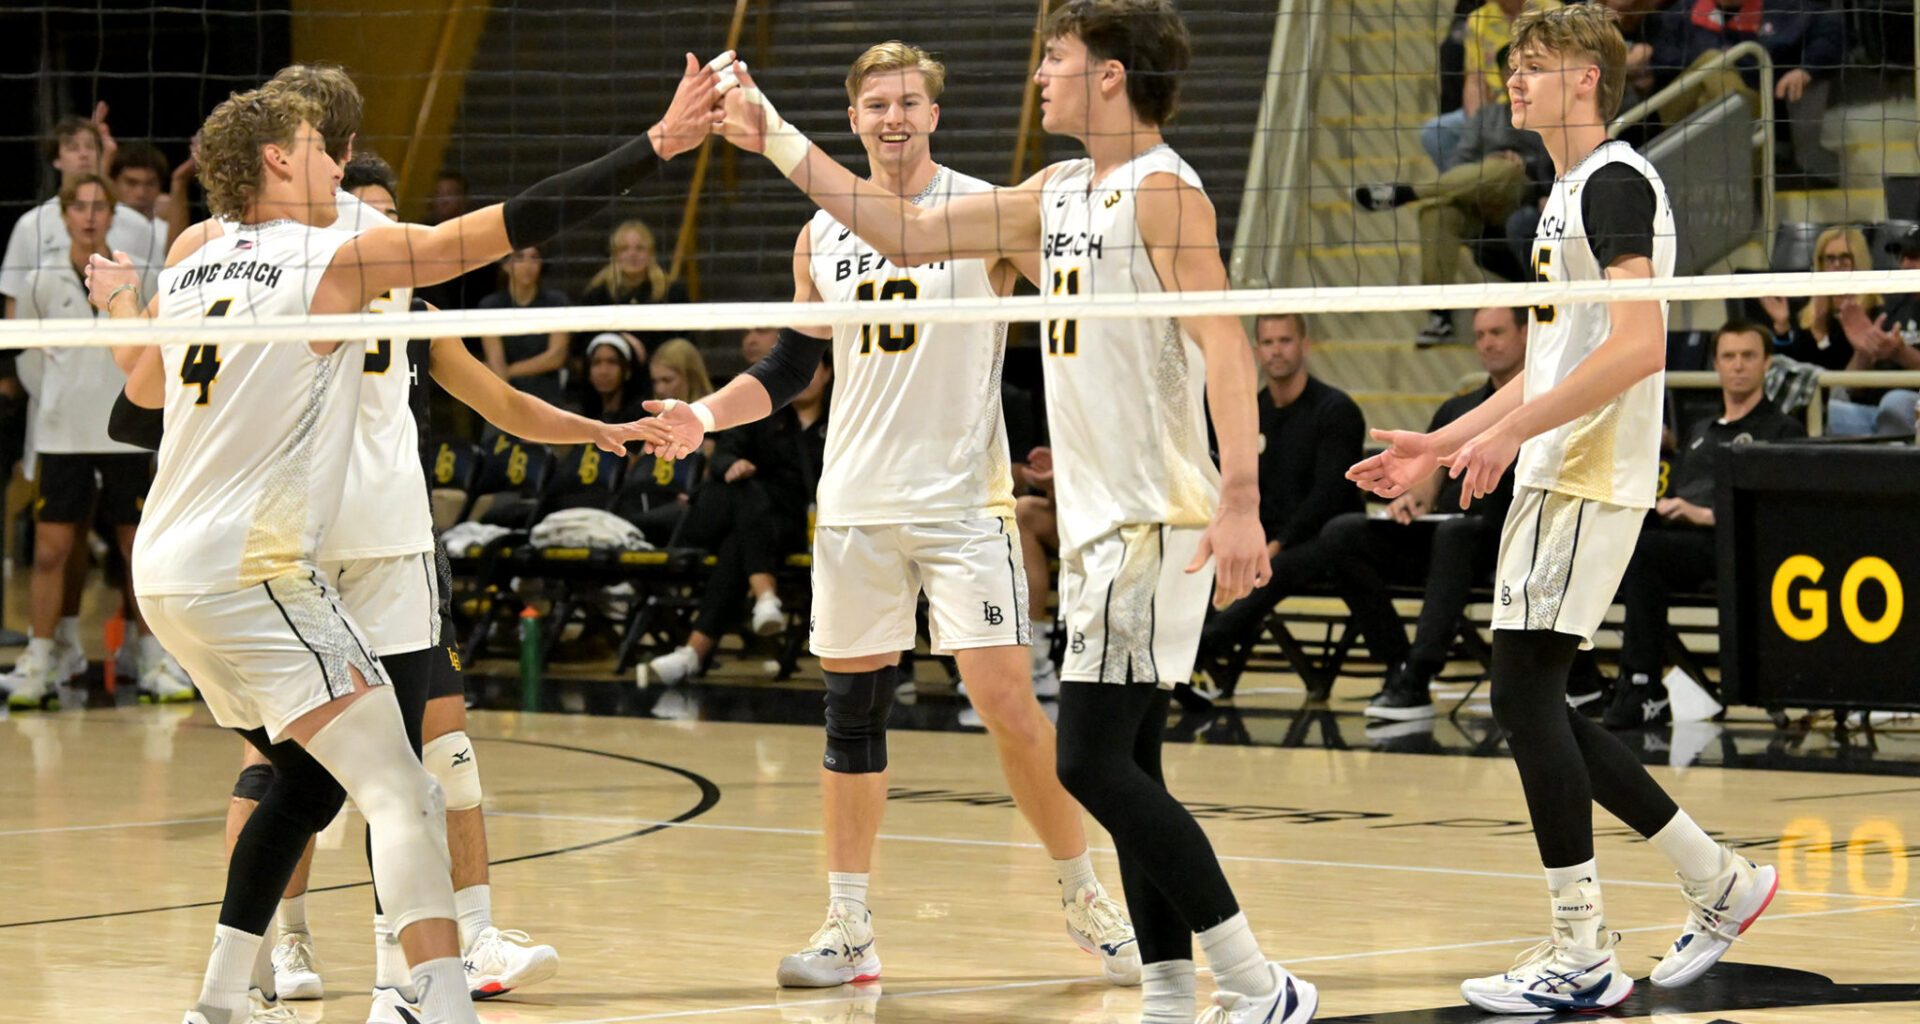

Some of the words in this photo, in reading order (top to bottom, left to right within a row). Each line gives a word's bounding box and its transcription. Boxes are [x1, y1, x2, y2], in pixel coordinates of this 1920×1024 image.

[168, 263, 222, 296] LONG
[223, 261, 283, 289] BEACH
[179, 297, 235, 407] 4
[1771, 554, 1904, 643] GO
